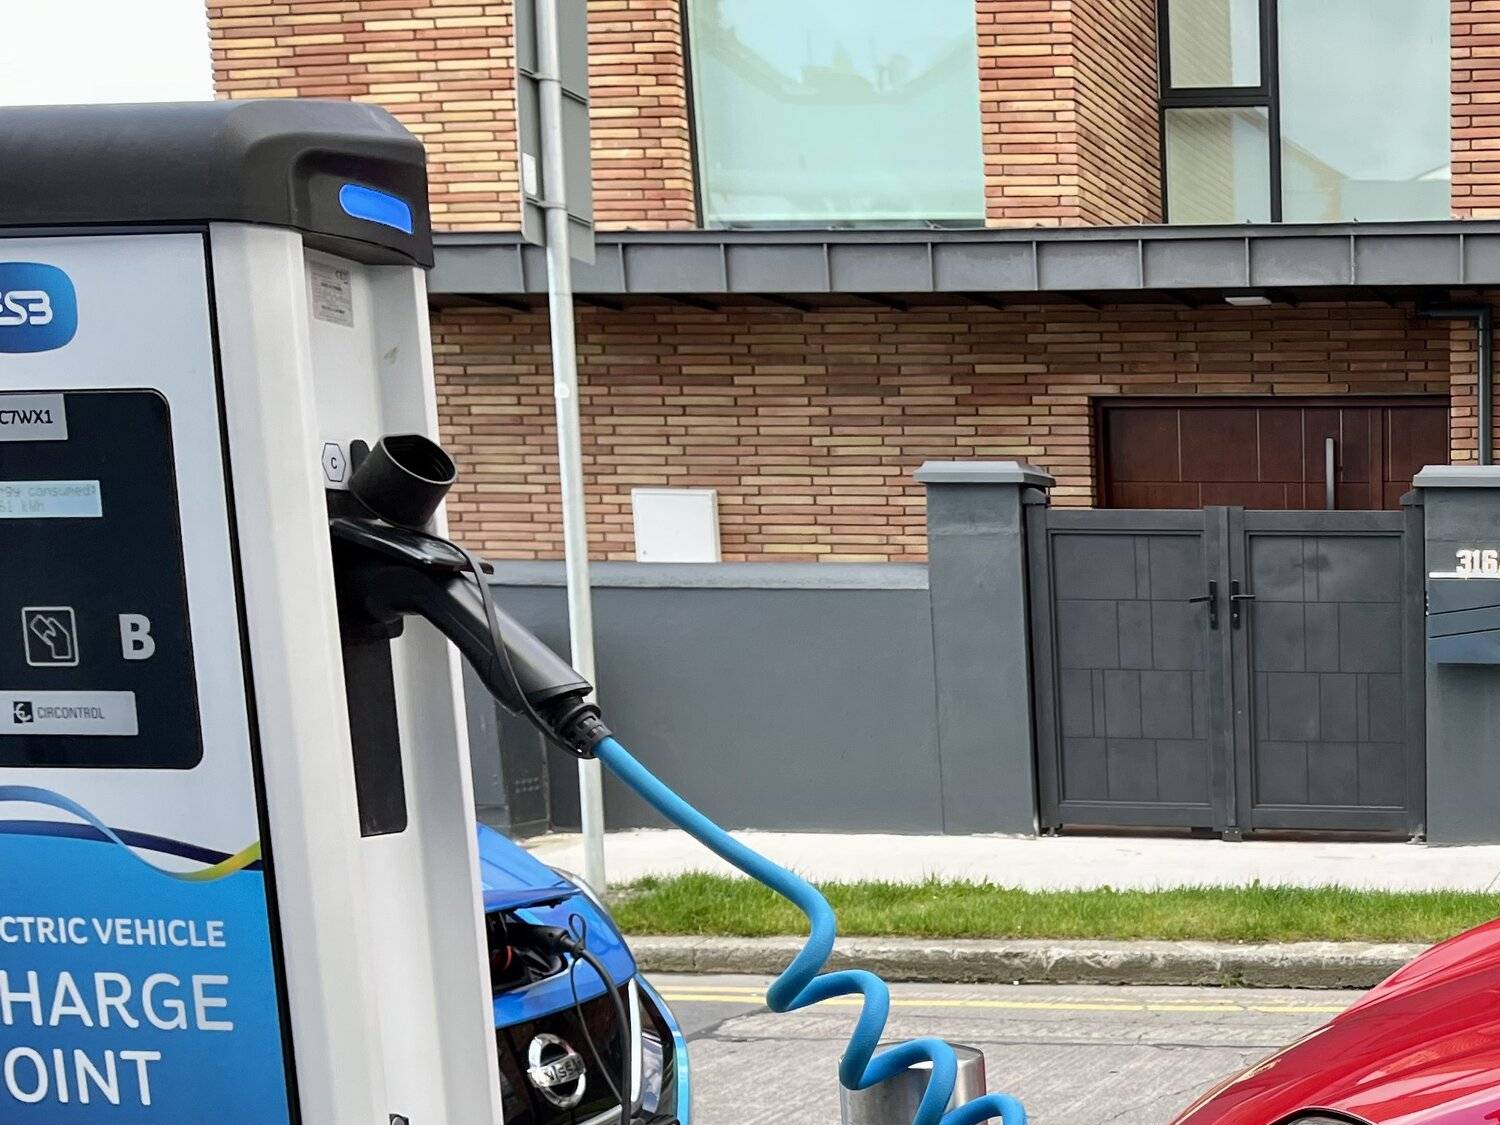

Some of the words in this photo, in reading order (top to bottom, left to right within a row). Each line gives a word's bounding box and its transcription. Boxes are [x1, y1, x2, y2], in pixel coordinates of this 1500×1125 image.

[0, 290, 53, 326] SB
[0, 410, 53, 424] C7WX1
[118, 613, 156, 660] B
[36, 706, 105, 720] CIRCONTROL
[0, 915, 88, 944] CTRIC
[91, 917, 227, 947] VEHICLE
[0, 968, 234, 1031] HARGE
[3, 1046, 162, 1106] OINT
